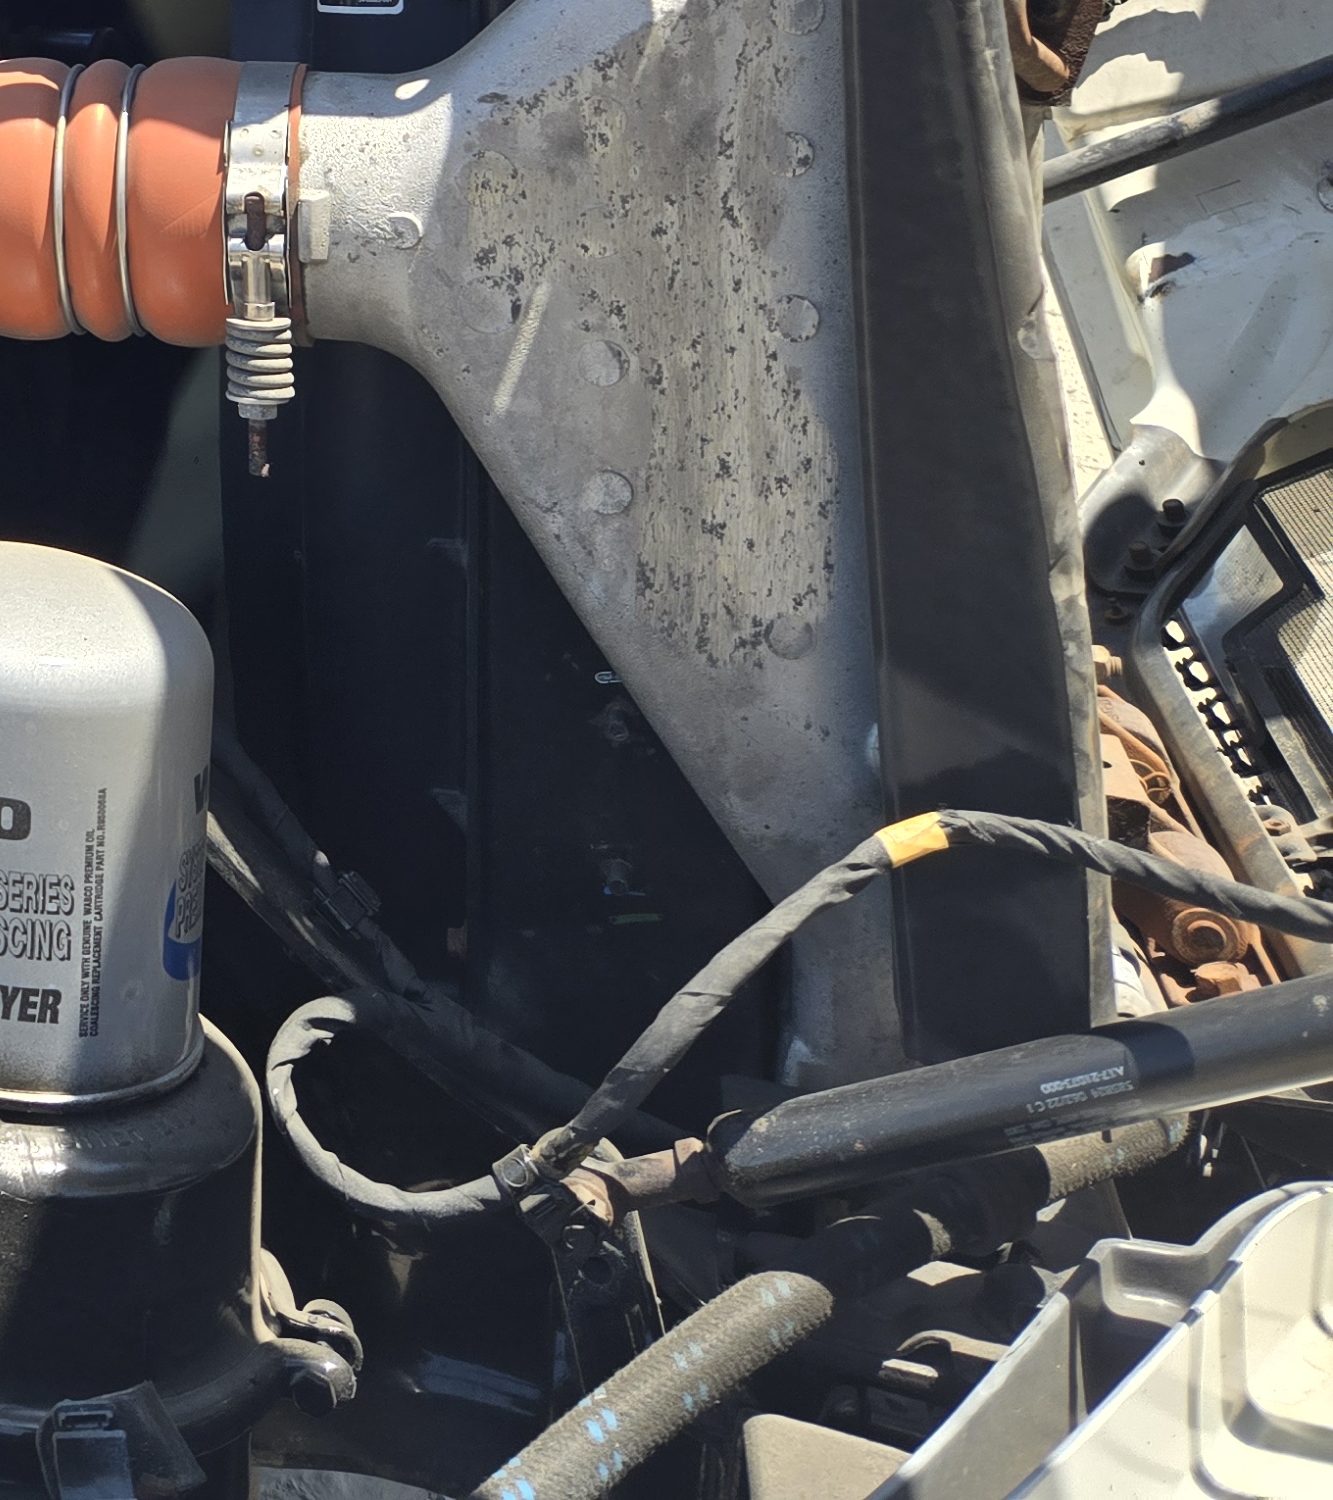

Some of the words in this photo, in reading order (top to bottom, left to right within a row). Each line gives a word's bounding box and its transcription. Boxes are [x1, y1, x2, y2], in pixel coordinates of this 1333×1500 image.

[85, 828, 96, 843] OIL
[83, 844, 95, 884] PREMIUM
[95, 848, 106, 872] PART
[82, 886, 94, 916] WABCO
[93, 873, 105, 922] CARTRIDGE
[81, 919, 93, 955] GENUINE
[91, 925, 103, 984] REPLACEMENT
[80, 956, 91, 979] WITH
[79, 980, 91, 1001] ONLY
[78, 1003, 90, 1038] SERVICE
[89, 986, 101, 1037] COALESCING
